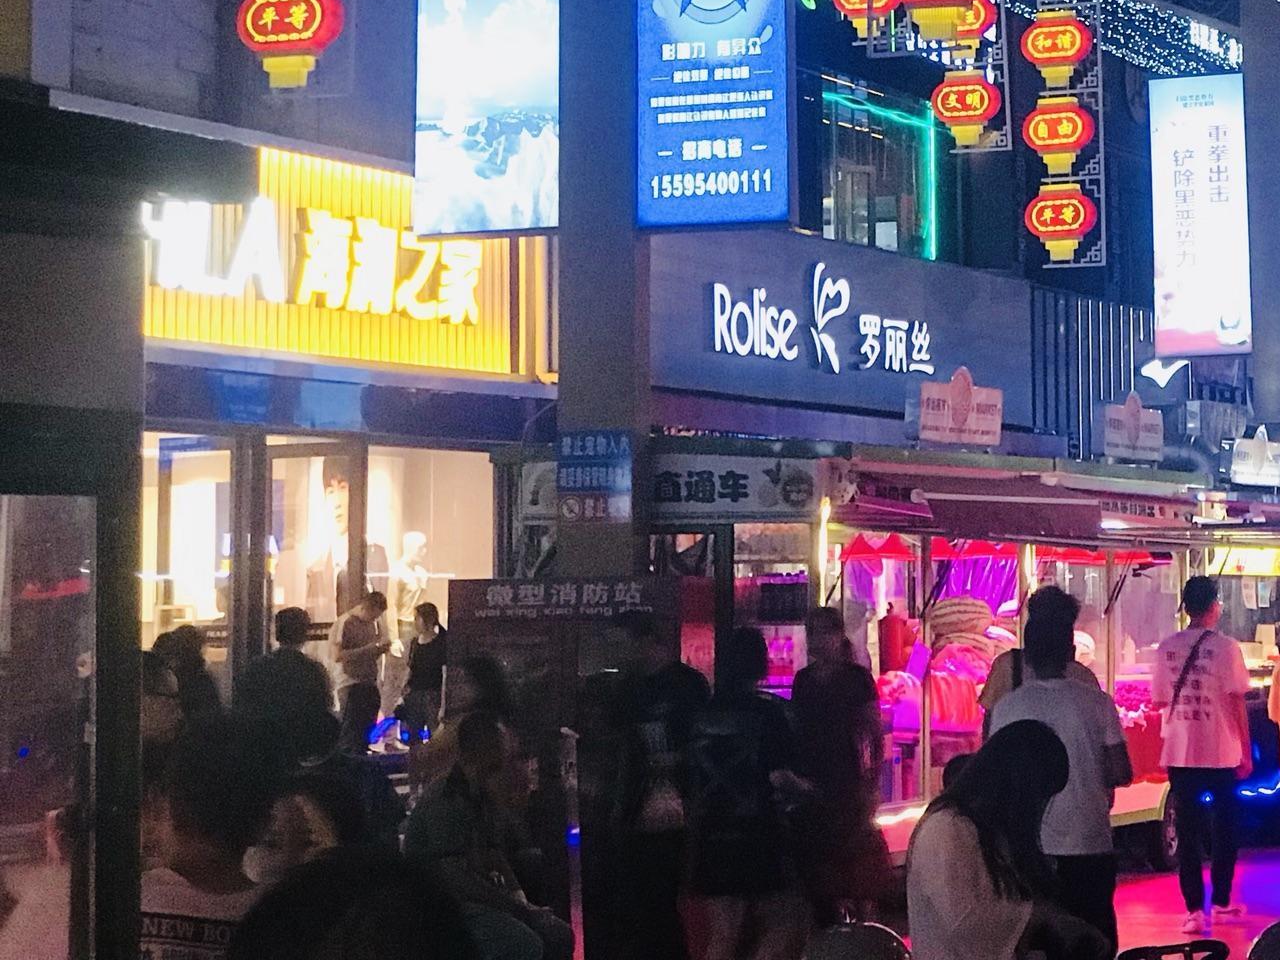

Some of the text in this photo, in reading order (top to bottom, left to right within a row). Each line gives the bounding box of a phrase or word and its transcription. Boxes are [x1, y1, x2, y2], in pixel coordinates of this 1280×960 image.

[258, 6, 310, 31] 平等
[944, 90, 981, 110] 文明
[1037, 119, 1073, 138] 自由
[651, 168, 772, 199] 15595400111
[1038, 206, 1076, 225] 平等
[713, 282, 798, 361] Rolise
[859, 314, 936, 375] 罗丽丝
[486, 582, 643, 607] 微型消防站
